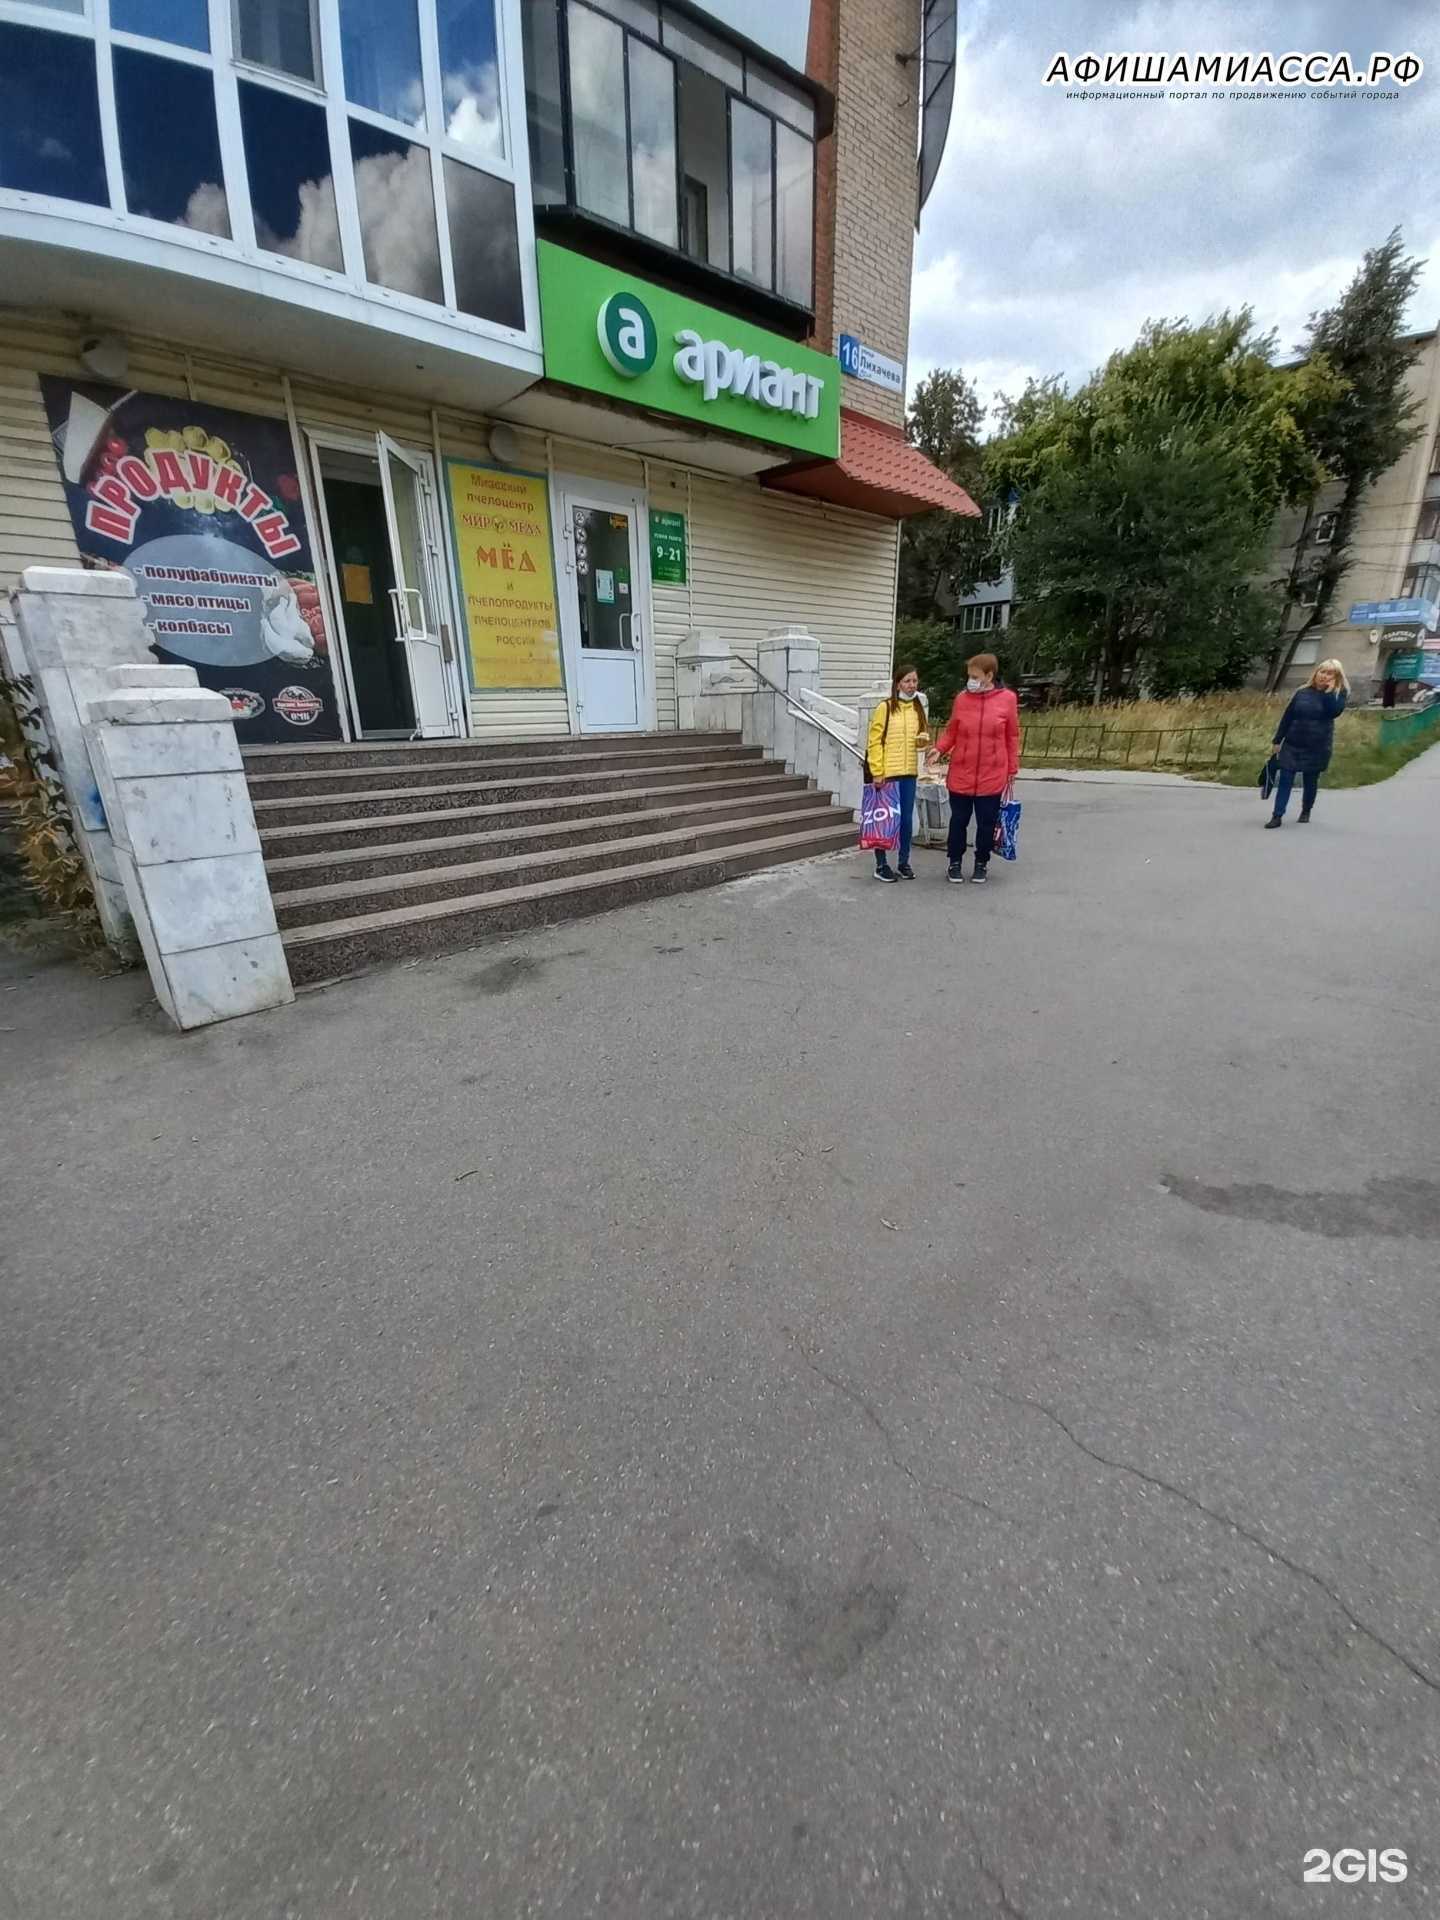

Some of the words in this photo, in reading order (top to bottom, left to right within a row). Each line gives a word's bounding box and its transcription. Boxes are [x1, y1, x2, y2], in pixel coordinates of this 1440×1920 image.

[842, 341, 859, 370] 16
[860, 355, 901, 384] Лихачева
[673, 329, 825, 420] ариант
[86, 449, 301, 559] ПРОДУКТЫ
[477, 541, 537, 573] МЁД
[145, 566, 278, 588] полуфабрикаты
[151, 594, 195, 607] мясо
[198, 597, 250, 611] птицы
[156, 620, 232, 634] колбасы
